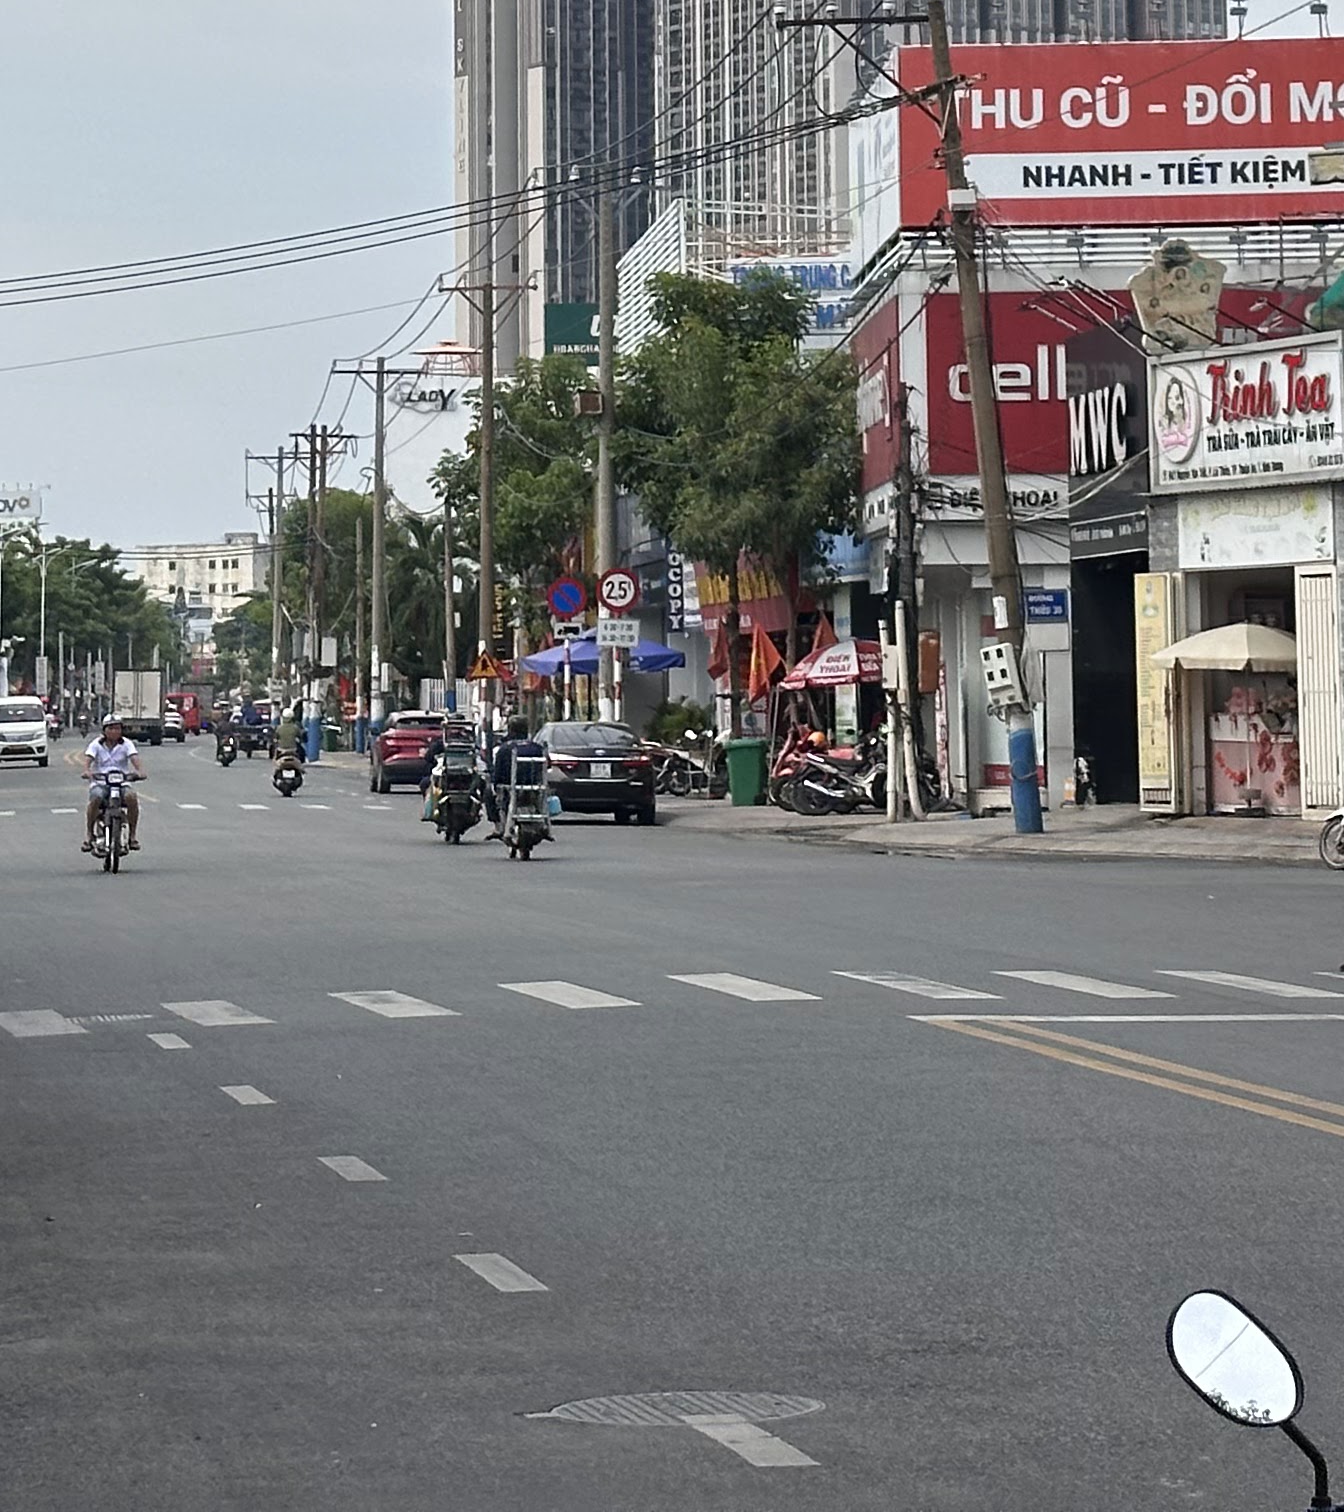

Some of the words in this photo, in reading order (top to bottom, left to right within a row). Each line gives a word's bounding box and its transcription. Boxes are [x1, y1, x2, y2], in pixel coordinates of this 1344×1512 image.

[1061, 75, 1130, 128] CŨ
[1183, 68, 1271, 125] ĐỔI
[1022, 164, 1133, 188] NHANH
[1158, 154, 1223, 186] TIẾT
[1231, 158, 1306, 190] KIỆM
[1282, 349, 1332, 415] Tea
[1069, 383, 1127, 476] MWC
[950, 487, 984, 511] ĐIỆ
[1008, 490, 1058, 510] HOẠI
